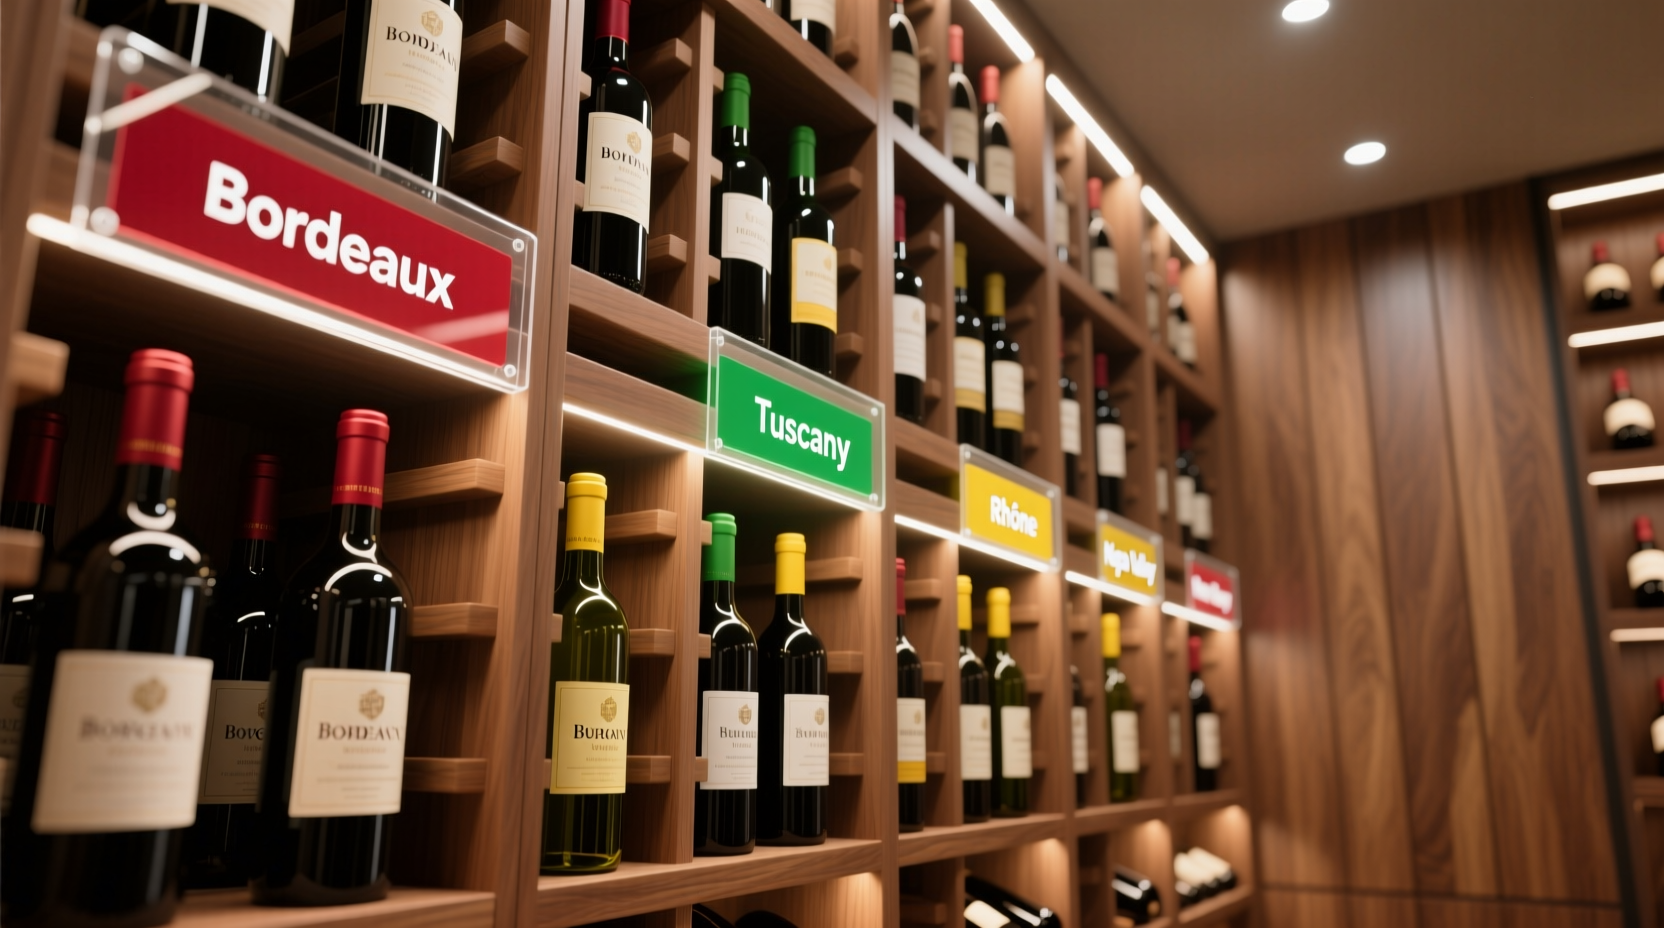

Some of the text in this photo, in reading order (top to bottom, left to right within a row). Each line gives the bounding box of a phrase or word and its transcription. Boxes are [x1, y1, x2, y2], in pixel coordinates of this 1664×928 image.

[203, 160, 456, 310] Bordeaux
[754, 395, 851, 472] Tuscany
[990, 494, 1039, 538] Rhône
